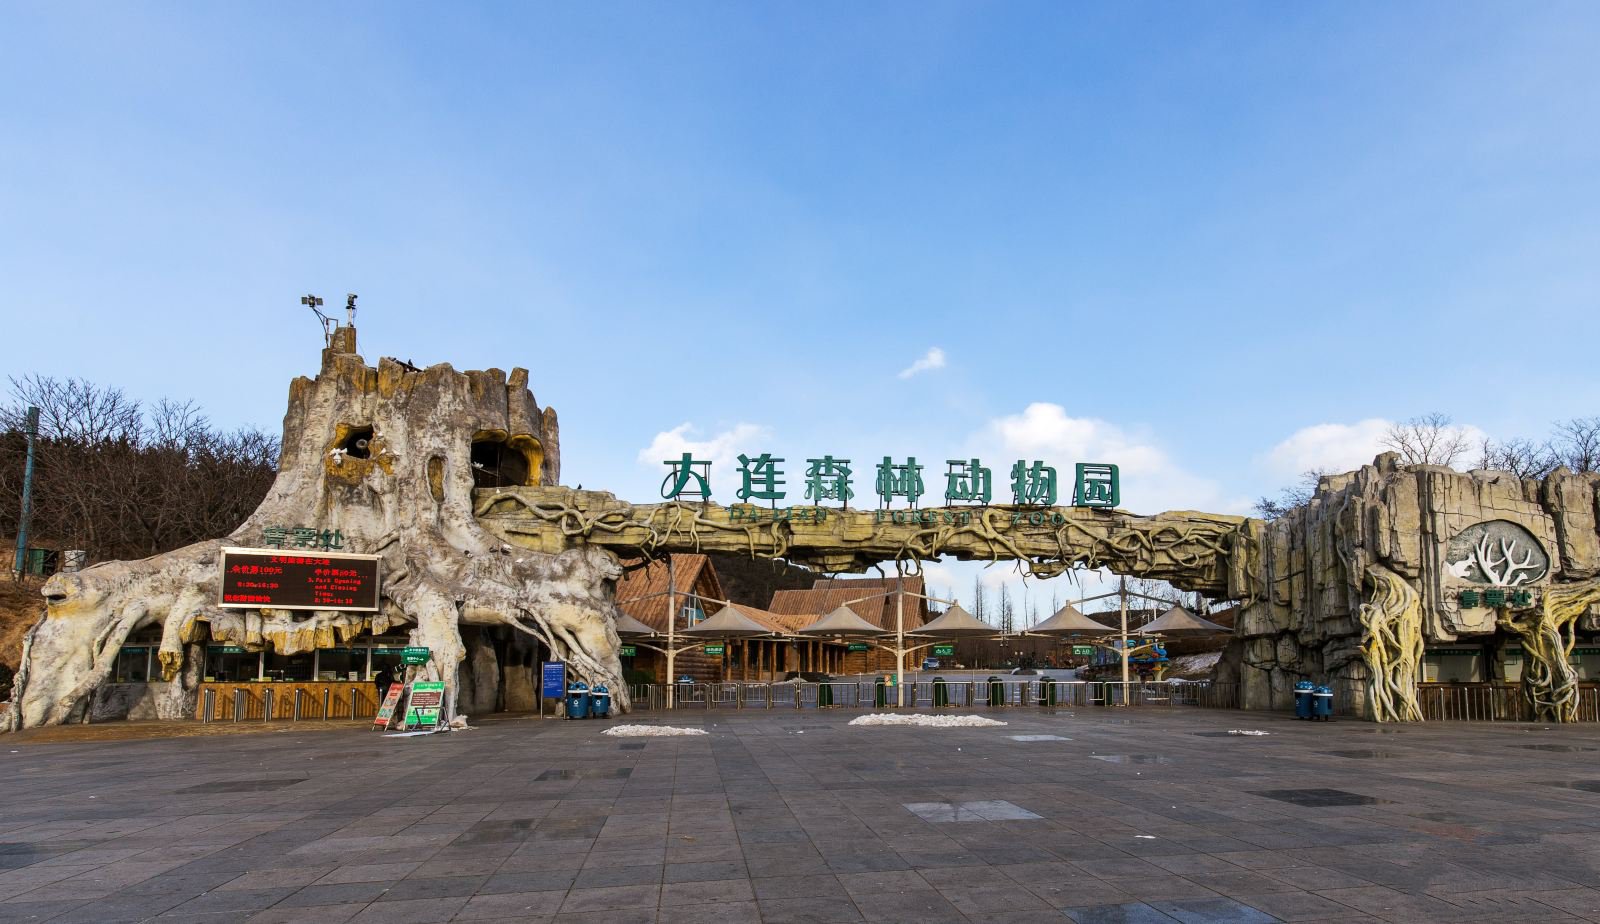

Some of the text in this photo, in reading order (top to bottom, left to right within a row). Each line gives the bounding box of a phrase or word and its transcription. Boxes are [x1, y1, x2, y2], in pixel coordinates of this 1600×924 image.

[661, 452, 1120, 507] 大连森林动物园
[875, 509, 971, 524] FOREST
[1012, 512, 1066, 525] ZOO
[264, 527, 344, 549] 售票处
